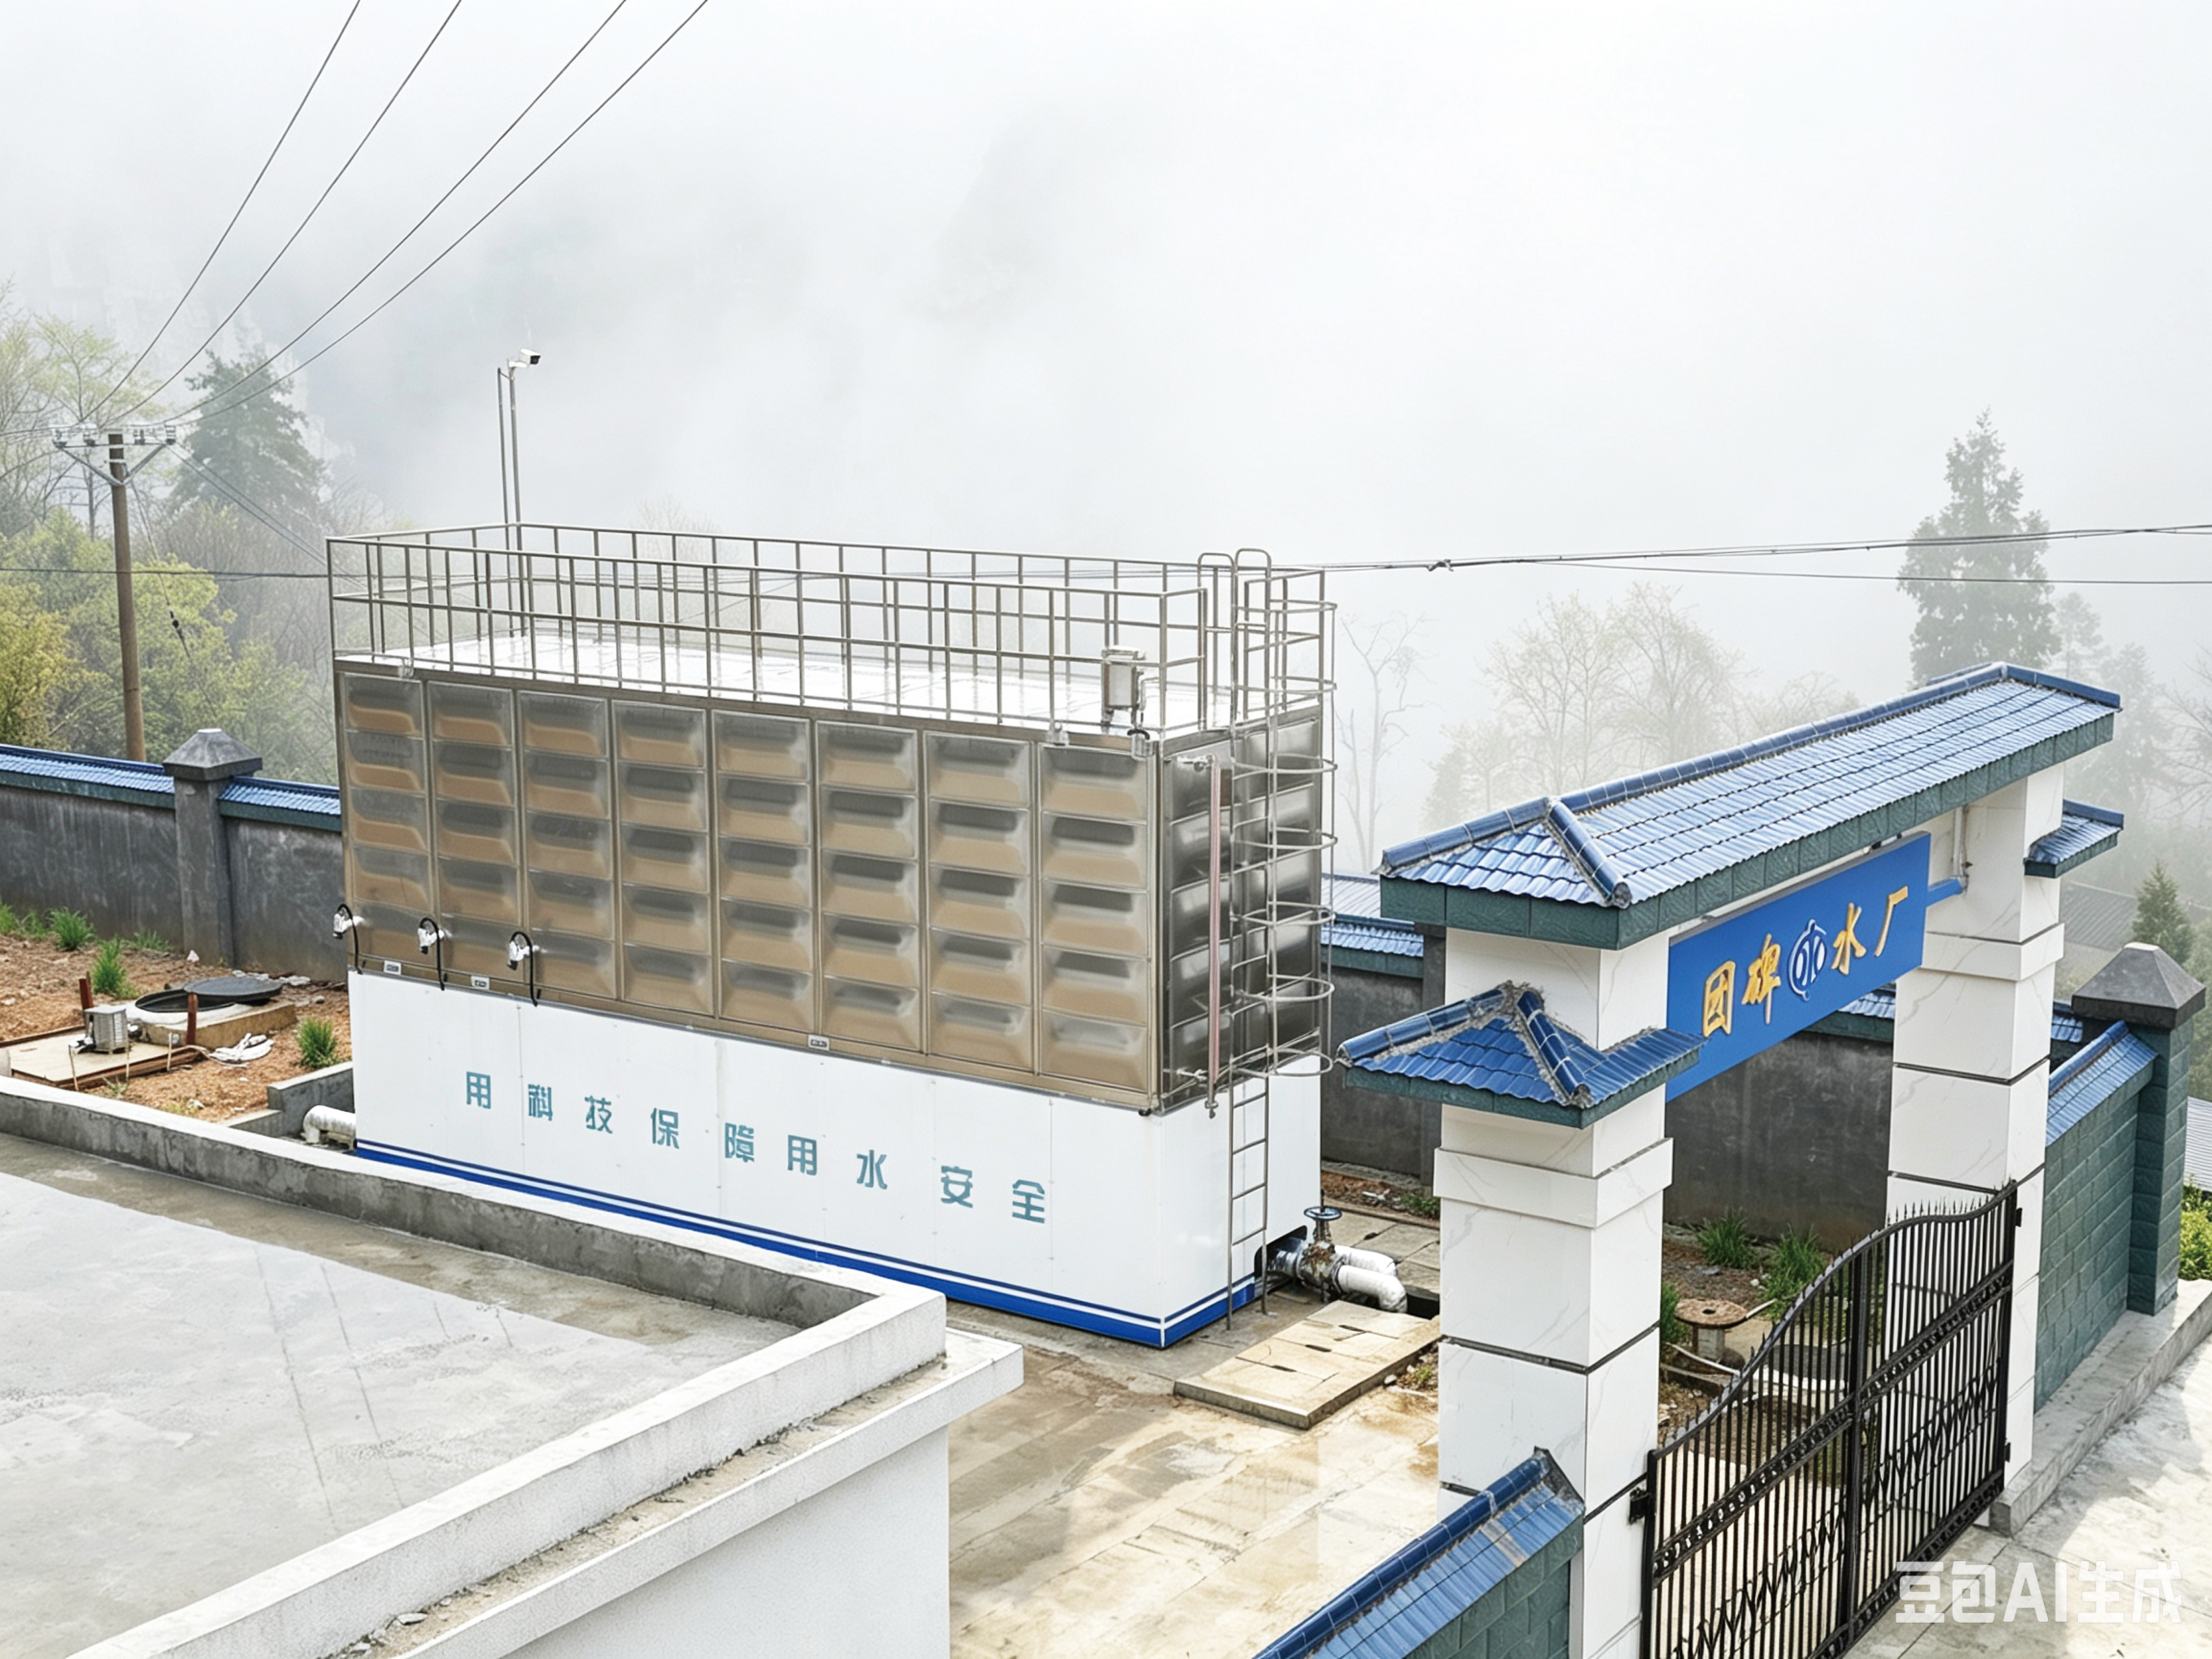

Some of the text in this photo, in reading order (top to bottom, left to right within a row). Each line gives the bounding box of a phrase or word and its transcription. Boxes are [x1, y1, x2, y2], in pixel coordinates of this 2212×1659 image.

[466, 1071, 1045, 1223] 用科技保障用水安全
